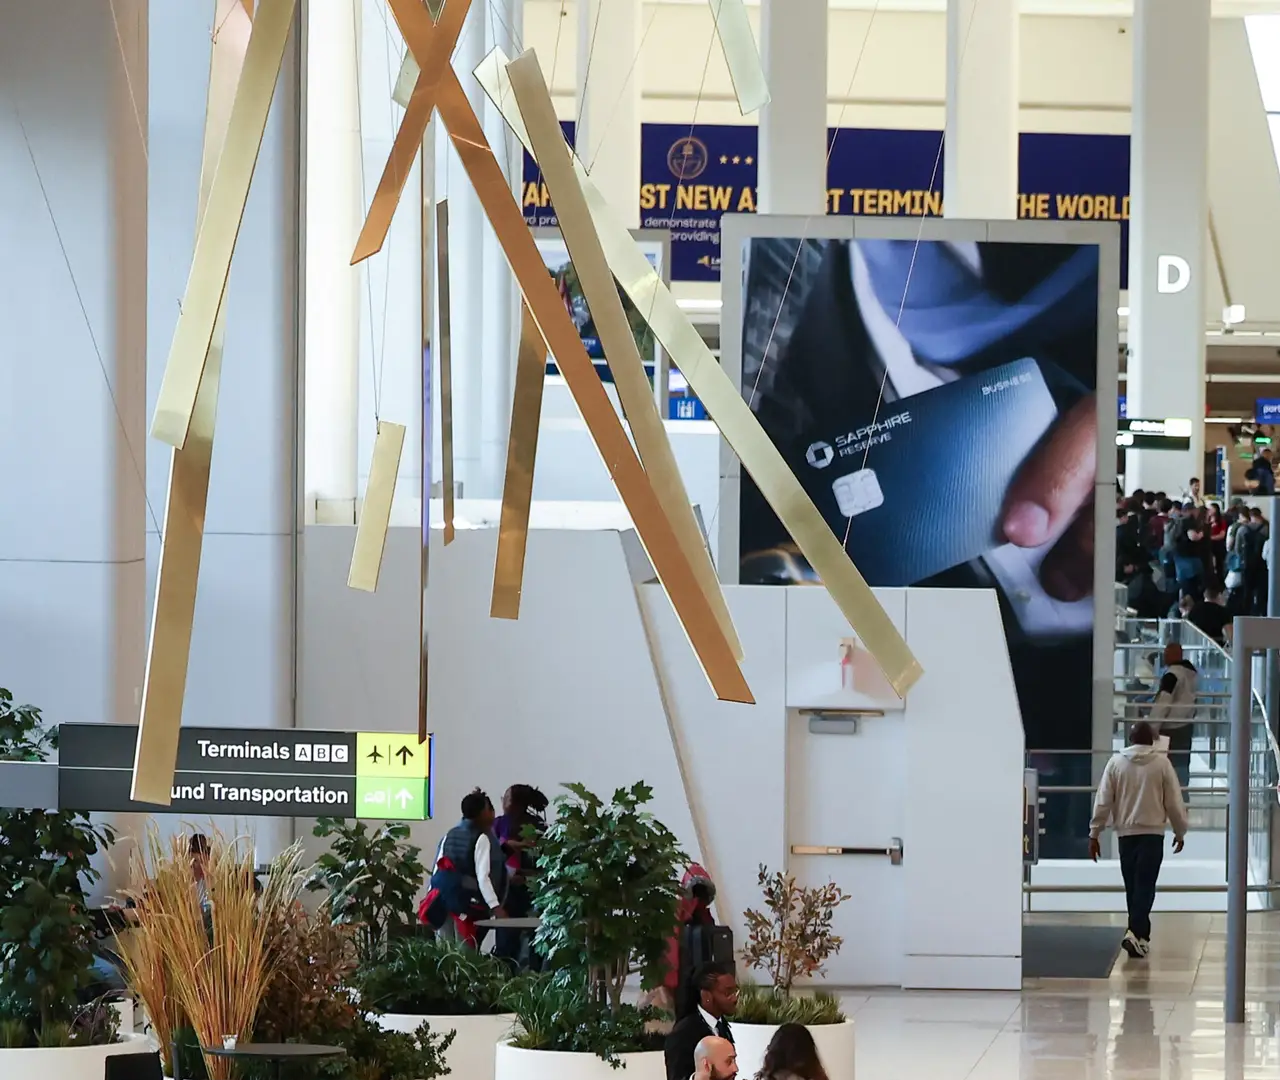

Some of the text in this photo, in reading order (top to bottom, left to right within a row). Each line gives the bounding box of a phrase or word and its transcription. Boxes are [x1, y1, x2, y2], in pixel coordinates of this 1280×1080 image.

[676, 186, 732, 211] NEW
[850, 189, 943, 215] TERMIN
[645, 218, 716, 228] demonstrate
[670, 231, 719, 244] providing
[1157, 255, 1191, 293] D
[835, 411, 912, 448] SAPPHIRE
[838, 431, 892, 458] RESERVE
[197, 740, 290, 760] Terminals
[170, 783, 348, 805] und Transportation
